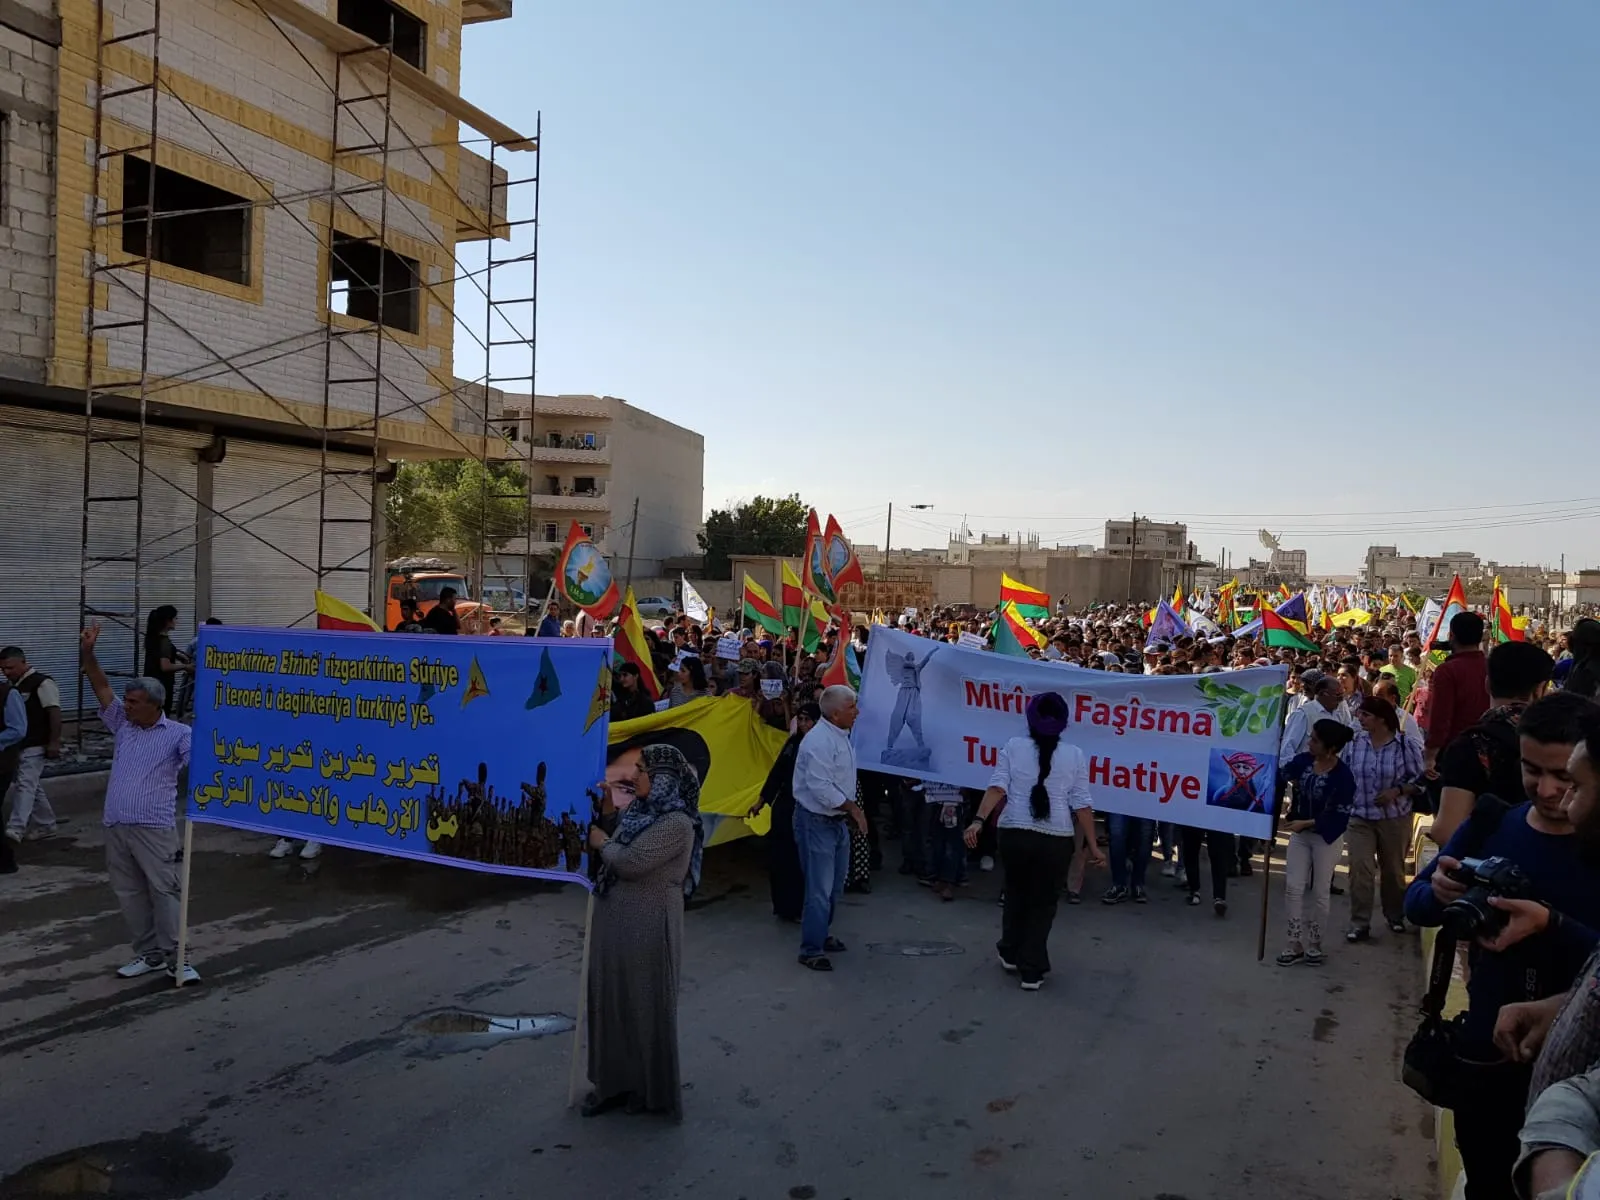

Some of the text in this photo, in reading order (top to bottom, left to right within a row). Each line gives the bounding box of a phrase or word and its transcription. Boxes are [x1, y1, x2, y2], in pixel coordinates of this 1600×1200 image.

[214, 680, 223, 710] ji
[1074, 694, 1212, 736] Faşîsma
[213, 728, 440, 789] تحرير عفرين تحرير سوريا
[1089, 756, 1201, 803] Hatiye
[194, 770, 459, 842] من الإرهاب والاحتلال التركي
